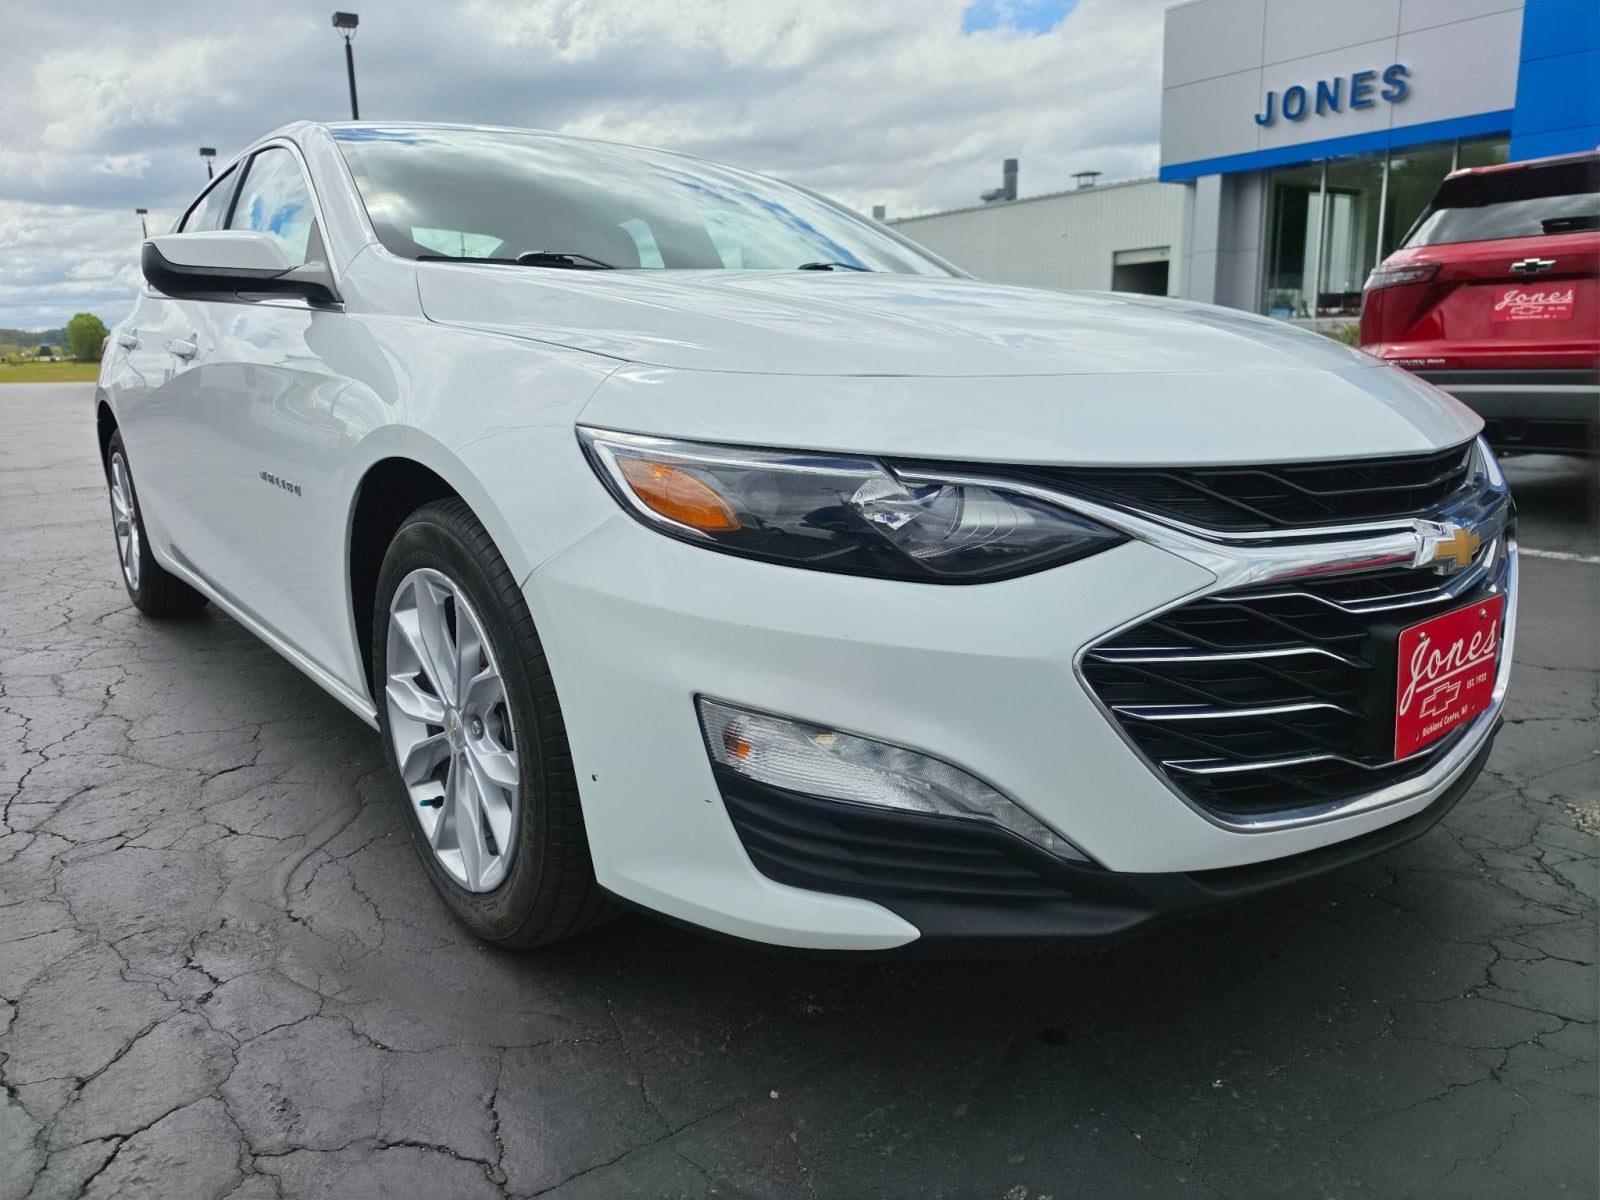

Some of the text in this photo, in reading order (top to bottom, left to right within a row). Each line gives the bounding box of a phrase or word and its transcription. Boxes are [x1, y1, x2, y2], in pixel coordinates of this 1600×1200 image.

[1254, 64, 1409, 126] JONES
[1494, 289, 1574, 311] Jones
[1400, 619, 1497, 716] Jones
[1422, 717, 1444, 737] Richland
